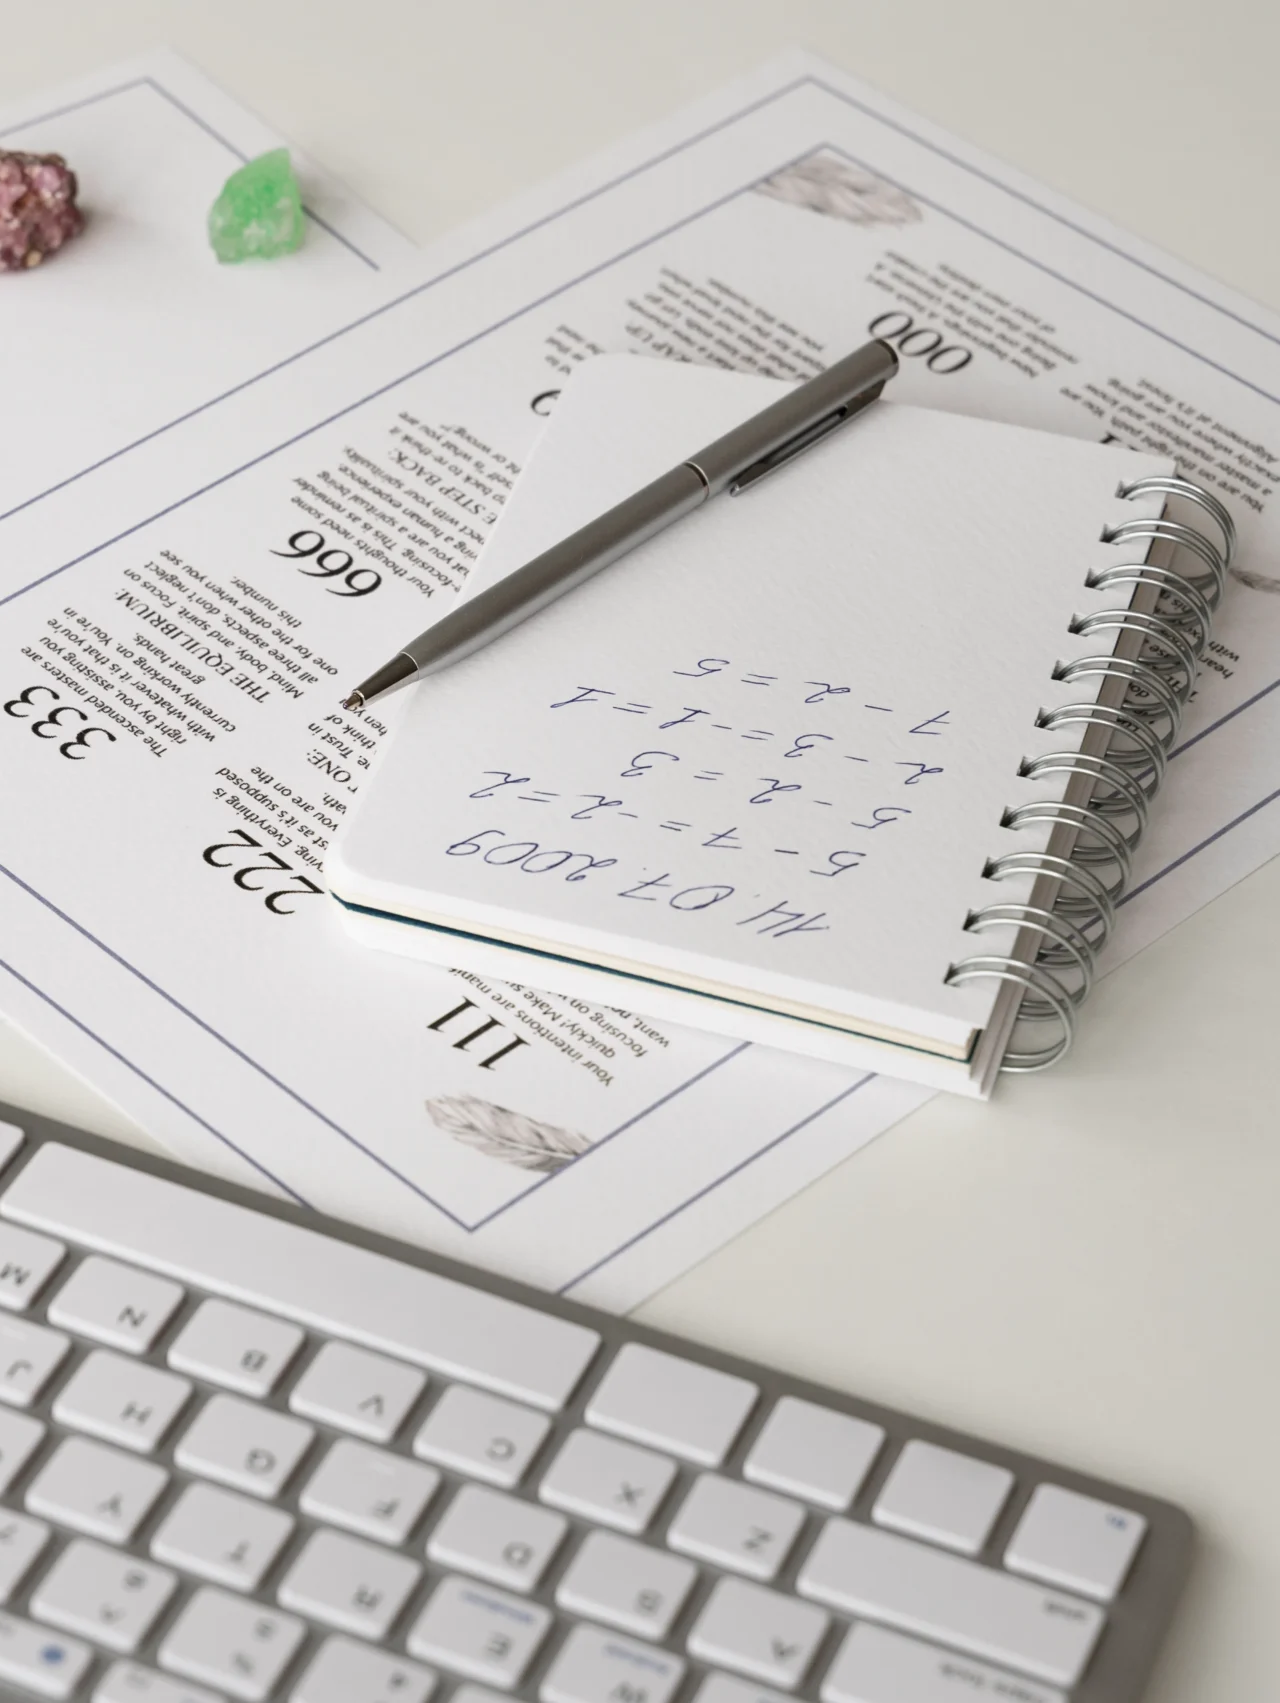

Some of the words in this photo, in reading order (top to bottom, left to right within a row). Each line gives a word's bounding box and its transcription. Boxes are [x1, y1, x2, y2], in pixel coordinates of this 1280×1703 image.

[867, 311, 973, 374] 000
[292, 477, 346, 513] reminder
[316, 470, 351, 497] being
[290, 496, 324, 519] some
[345, 511, 362, 523] as
[347, 493, 398, 527] spiritual
[319, 518, 354, 540] need
[360, 521, 373, 532] is
[397, 525, 408, 533] a
[371, 529, 397, 551] This
[406, 533, 429, 547] are
[159, 550, 183, 565] see
[270, 530, 382, 597] 666
[353, 539, 408, 577] thoughts
[427, 546, 454, 564] you
[123, 568, 141, 581] on
[143, 560, 189, 593] neglect
[181, 565, 207, 582] you
[140, 581, 176, 608] Focus
[204, 581, 238, 606] when
[230, 576, 278, 611] number.
[406, 576, 434, 598] Your
[63, 607, 77, 619] in
[187, 591, 220, 614] don't
[177, 605, 211, 630] spirit.
[237, 606, 272, 628] other
[277, 610, 301, 628] this
[47, 618, 86, 646] you're
[76, 617, 112, 646] You're
[115, 588, 234, 676] EQUILIBRIUM:
[206, 630, 234, 647] and
[222, 613, 269, 648] aspects,
[271, 628, 294, 645] the
[20, 646, 43, 661] are
[39, 636, 66, 655] you
[82, 644, 110, 665] that
[115, 643, 134, 658] on.
[133, 632, 171, 663] hands.
[292, 644, 312, 659] for
[1202, 640, 1239, 662] with
[108, 663, 122, 675] is
[235, 646, 268, 673] body,
[267, 648, 301, 673] three
[312, 657, 338, 675] one
[672, 657, 730, 679] 5
[40, 661, 88, 696] masters
[61, 652, 114, 691] assisting
[118, 671, 132, 682] it
[132, 656, 181, 694] working
[168, 660, 205, 684] great
[297, 671, 318, 683] all
[229, 672, 270, 703] THE
[266, 670, 304, 699] Mind,
[805, 680, 850, 704] 2
[114, 689, 142, 711] you,
[129, 680, 187, 721] whatever
[3, 685, 116, 760] 333
[83, 694, 145, 737] ascended
[137, 709, 157, 724] by
[179, 692, 236, 732] currently
[323, 714, 343, 724] of
[908, 710, 952, 736] 7
[154, 720, 186, 744] right
[186, 719, 215, 742] with
[307, 722, 323, 735] in
[342, 724, 376, 749] think
[142, 736, 167, 757] The
[320, 732, 353, 759] Trust
[250, 766, 274, 784] the
[306, 748, 351, 782] ONE:
[624, 750, 679, 777] 3
[212, 787, 227, 799] is
[214, 767, 279, 811] supposed
[272, 782, 291, 796] on
[749, 778, 801, 804] 2
[291, 795, 314, 812] are
[224, 795, 292, 847] Everything
[276, 810, 299, 828] it's
[312, 812, 338, 831] you
[852, 805, 911, 830] 5
[296, 824, 315, 837] as
[202, 828, 324, 914] 222
[490, 993, 515, 1010] are
[523, 990, 562, 1021] Make
[569, 998, 590, 1013] on
[426, 996, 529, 1069] 111
[514, 1010, 583, 1060] intentions
[559, 1019, 615, 1058] quickly!
[588, 1011, 647, 1057] focusing
[632, 1017, 669, 1047] want,
[581, 1060, 613, 1086] Your
[0, 1263, 30, 1286] M
[119, 1307, 144, 1329] N
[5, 1360, 31, 1380] J
[242, 1350, 266, 1372] B
[121, 1404, 150, 1425] H
[360, 1396, 383, 1416] V
[487, 1438, 516, 1461] C
[373, 1499, 401, 1518] F
